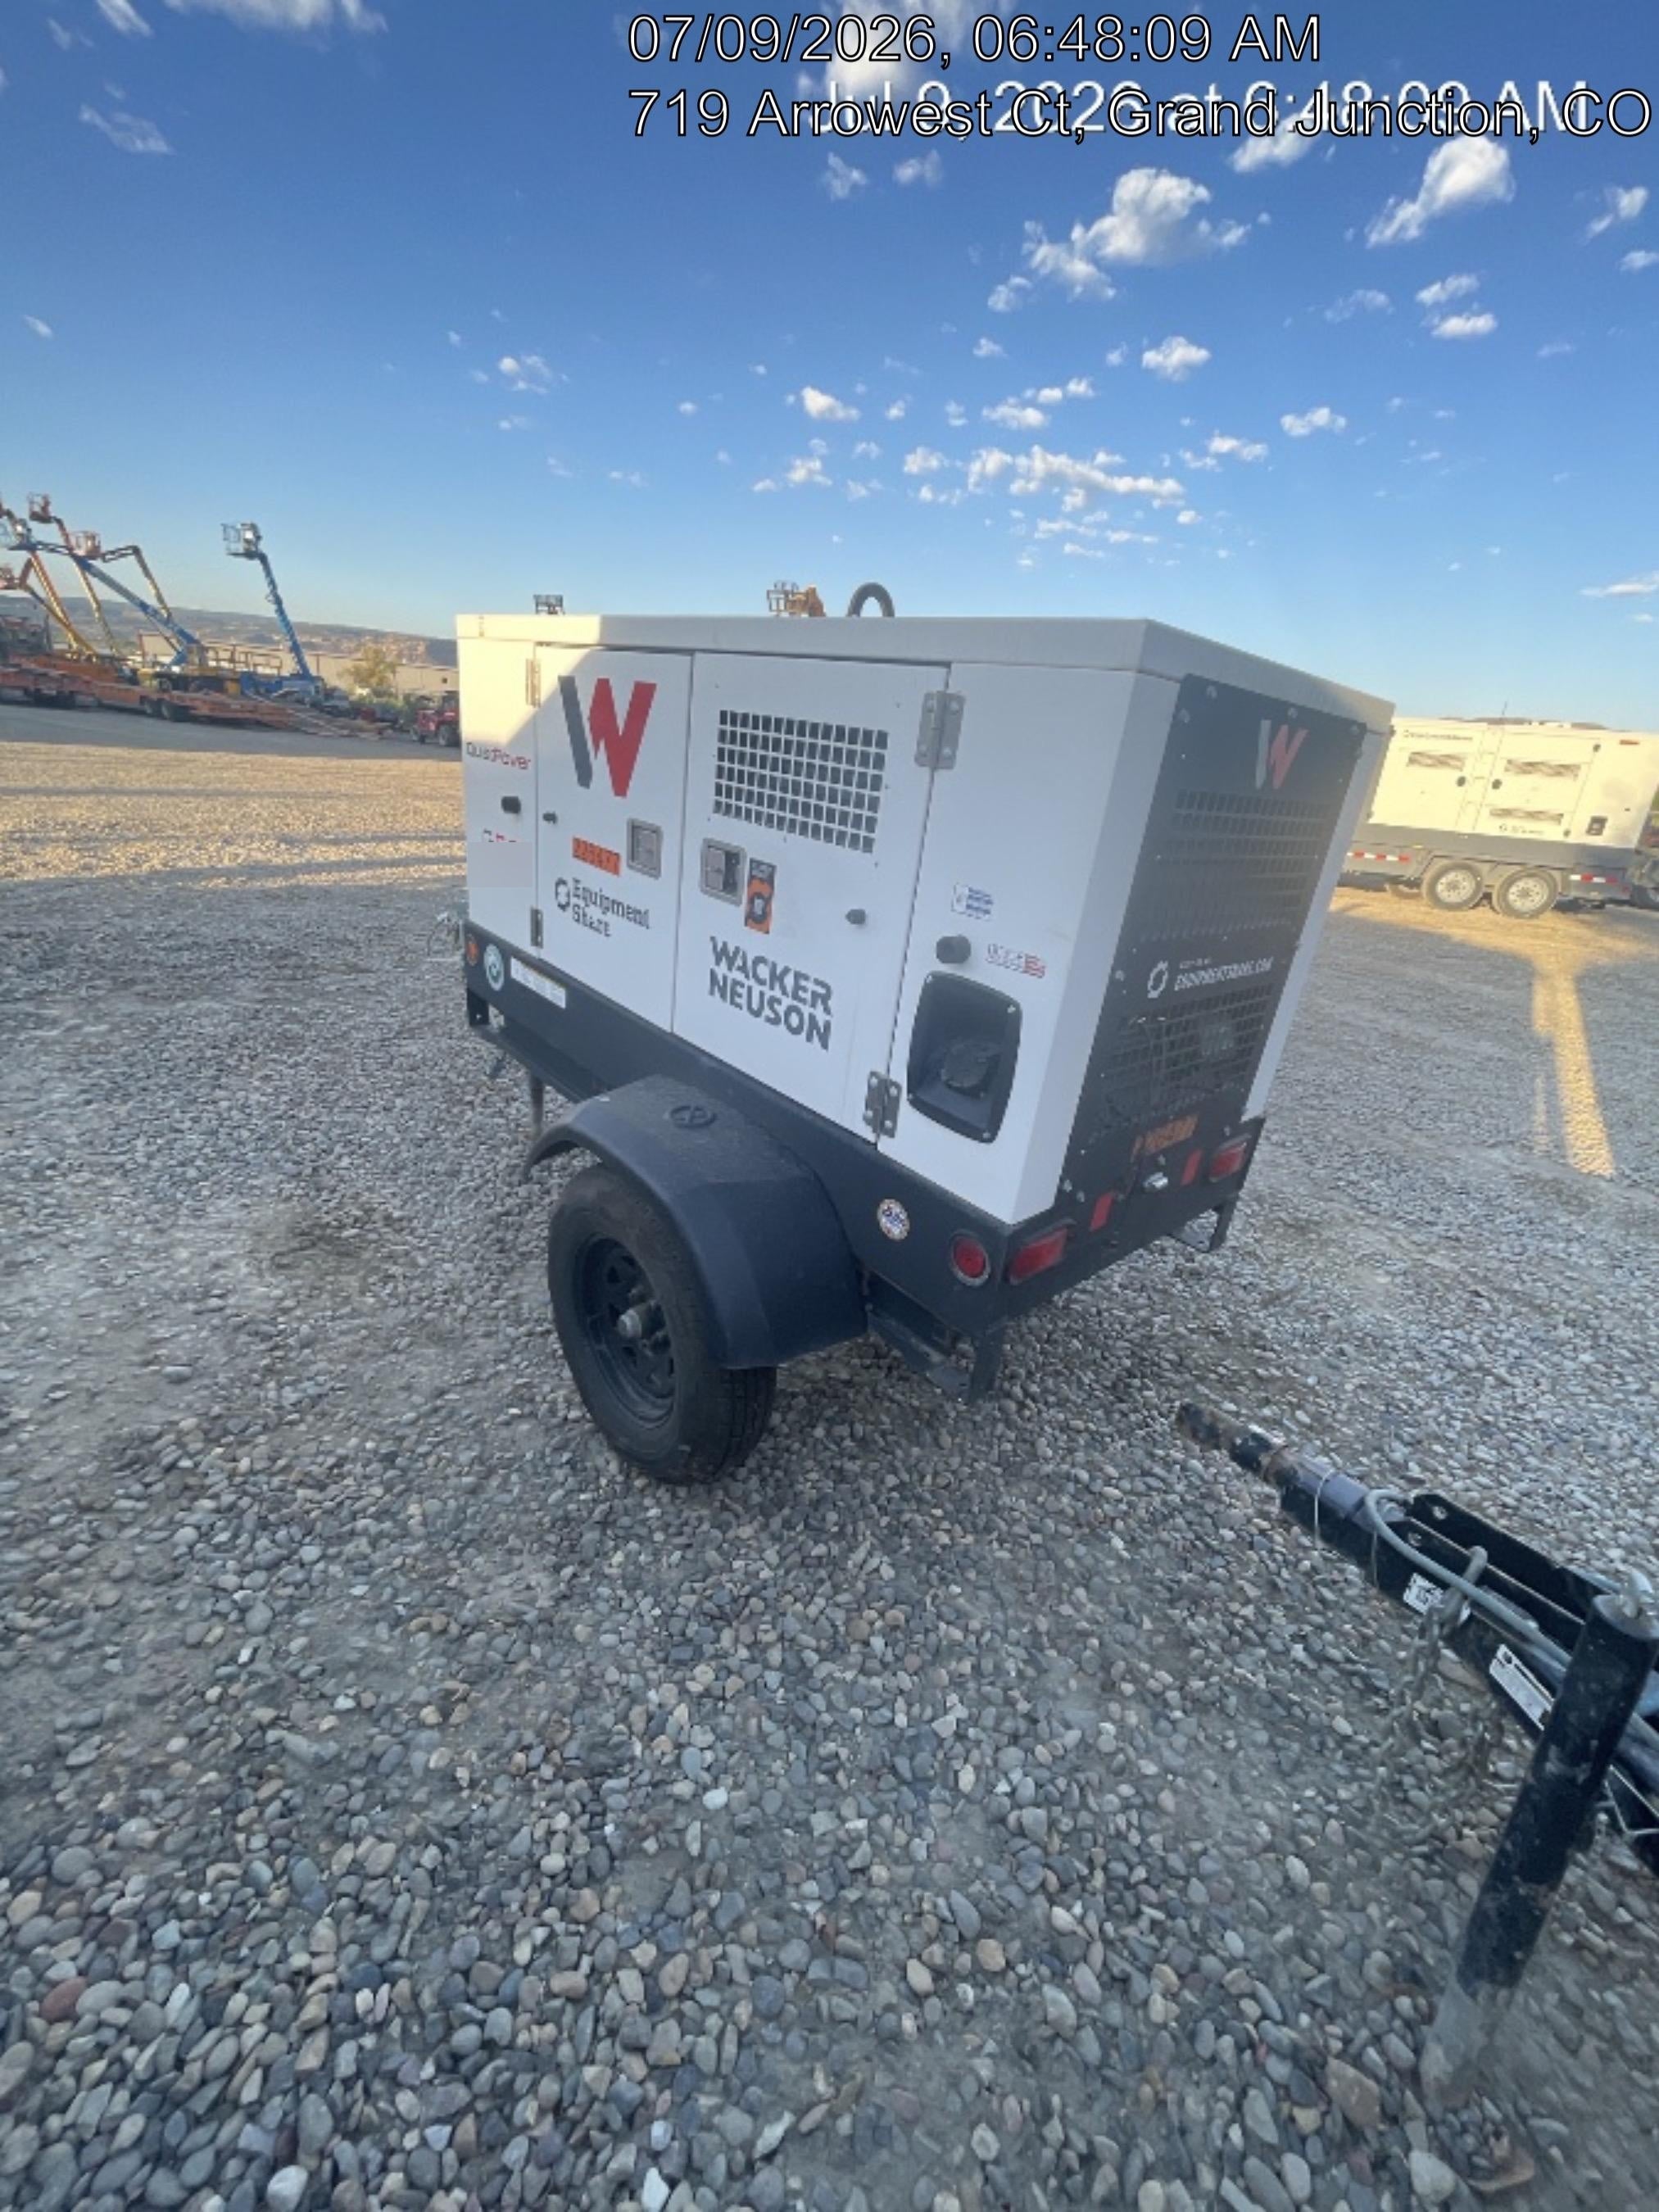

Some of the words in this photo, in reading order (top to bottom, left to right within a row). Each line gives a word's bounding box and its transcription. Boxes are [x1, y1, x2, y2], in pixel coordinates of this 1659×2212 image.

[572, 877, 650, 930] Equipment
[709, 936, 832, 1017] WACKER
[709, 968, 832, 1051] NEUSON
